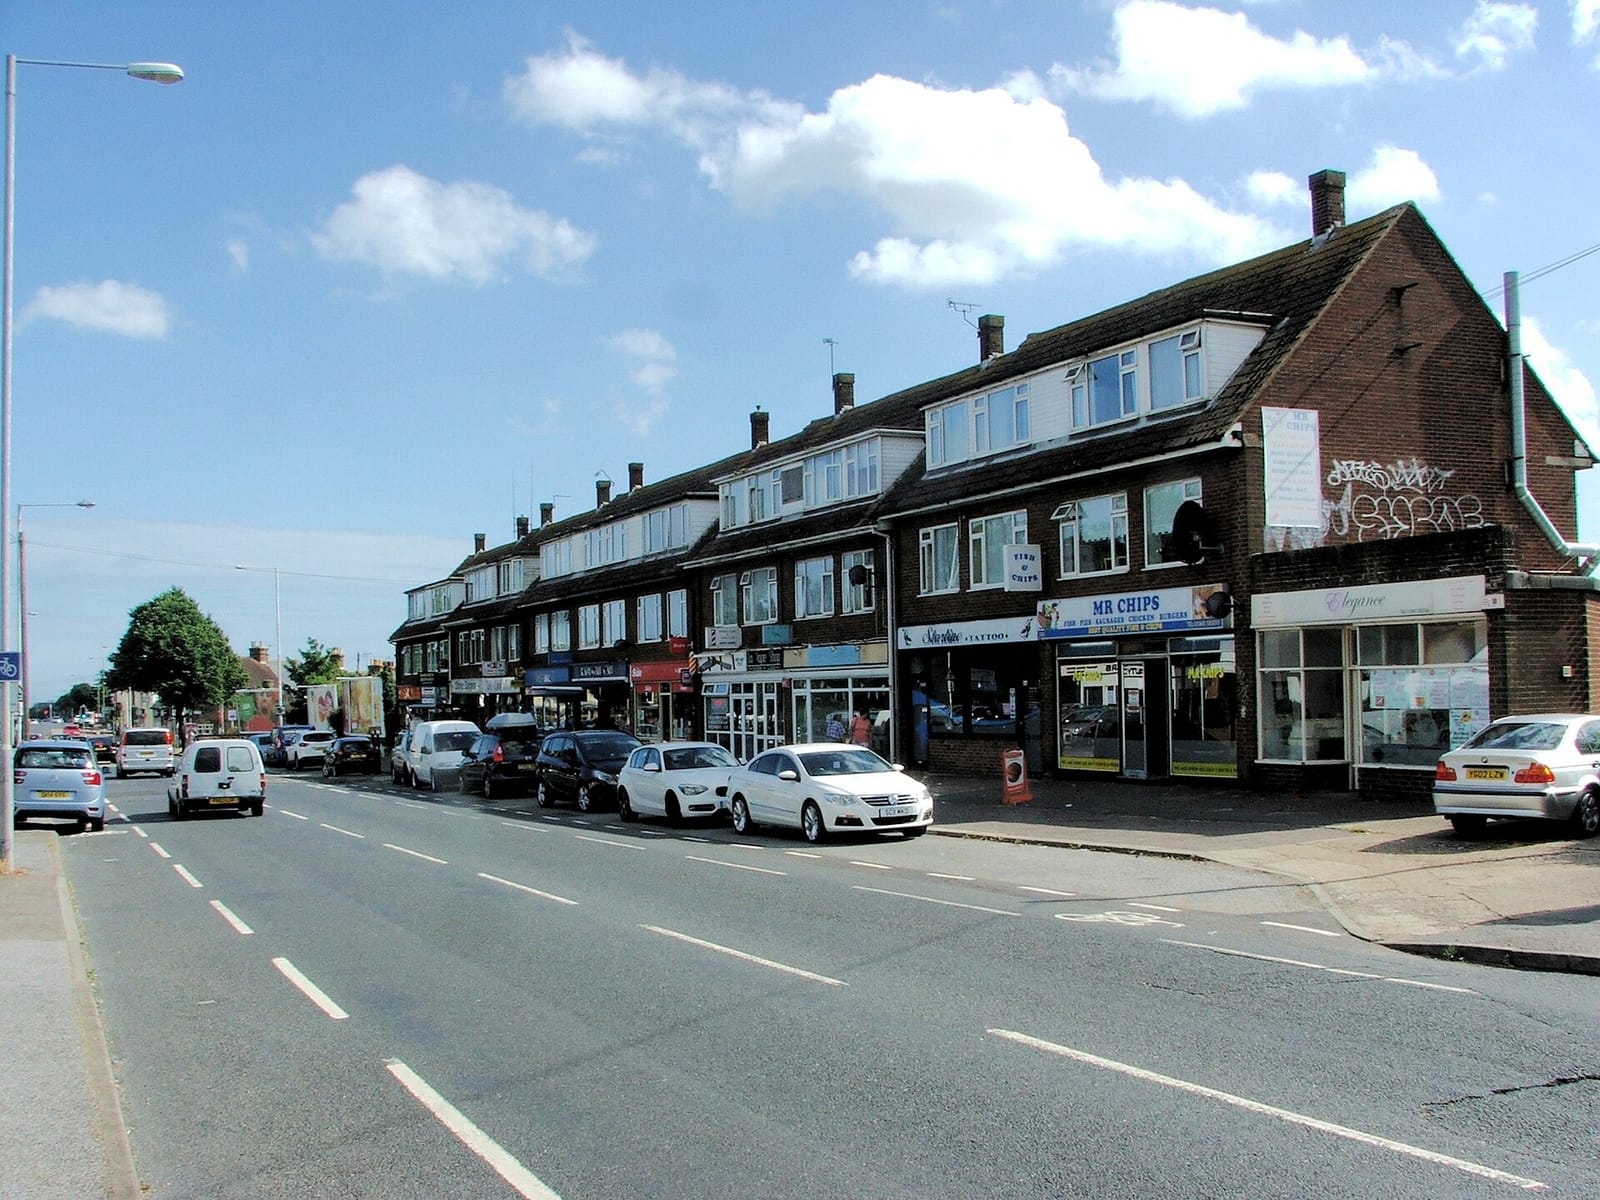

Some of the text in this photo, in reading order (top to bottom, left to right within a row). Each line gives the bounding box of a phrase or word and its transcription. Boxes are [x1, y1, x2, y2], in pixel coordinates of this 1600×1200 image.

[1014, 553, 1035, 561] FISH
[1012, 574, 1038, 582] CHIPS
[1093, 596, 1160, 616] MR CHIPS
[1325, 591, 1386, 617] Elegance
[1128, 613, 1155, 623] CHICKEN
[1159, 611, 1188, 621] BURGERS
[968, 632, 1005, 641] TATTOO
